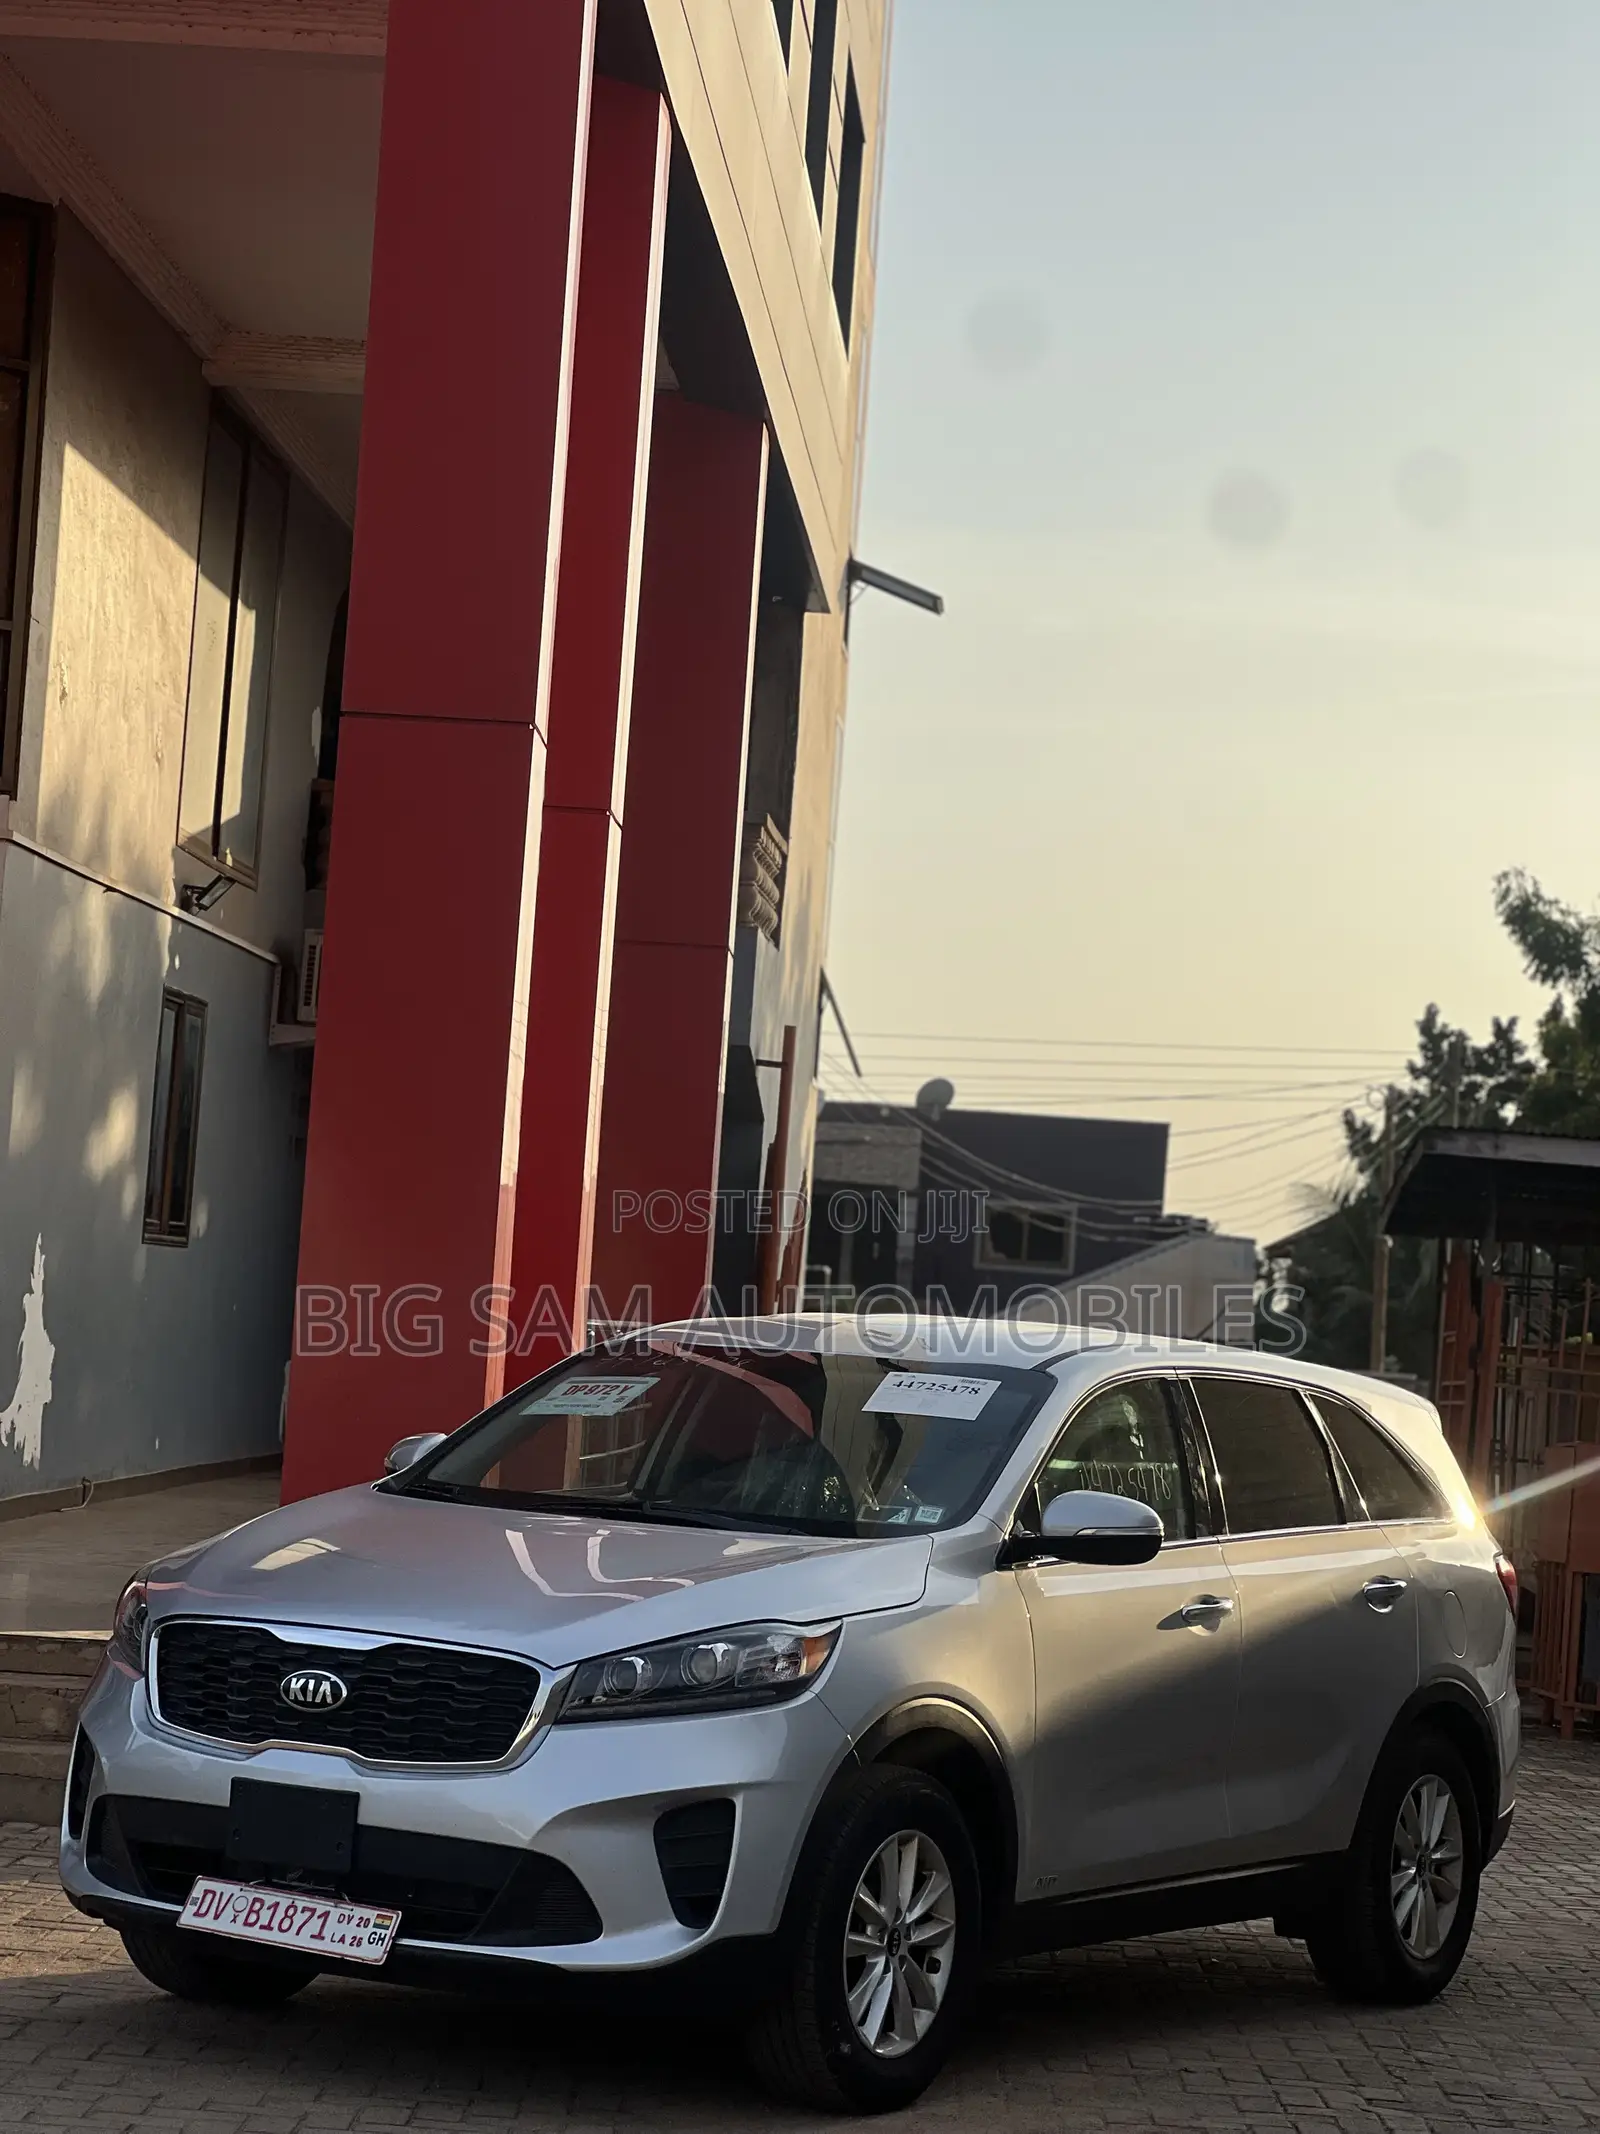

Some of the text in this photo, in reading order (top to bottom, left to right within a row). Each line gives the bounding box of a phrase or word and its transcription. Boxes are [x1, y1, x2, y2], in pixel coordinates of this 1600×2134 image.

[892, 1379, 981, 1396] 44725478
[289, 1677, 333, 1704] KIA
[192, 1888, 234, 1921] DV
[242, 1896, 331, 1941] B1871
[336, 1912, 371, 1929] DV 20
[329, 1932, 364, 1948] LA 26
[366, 1930, 387, 1947] GH
